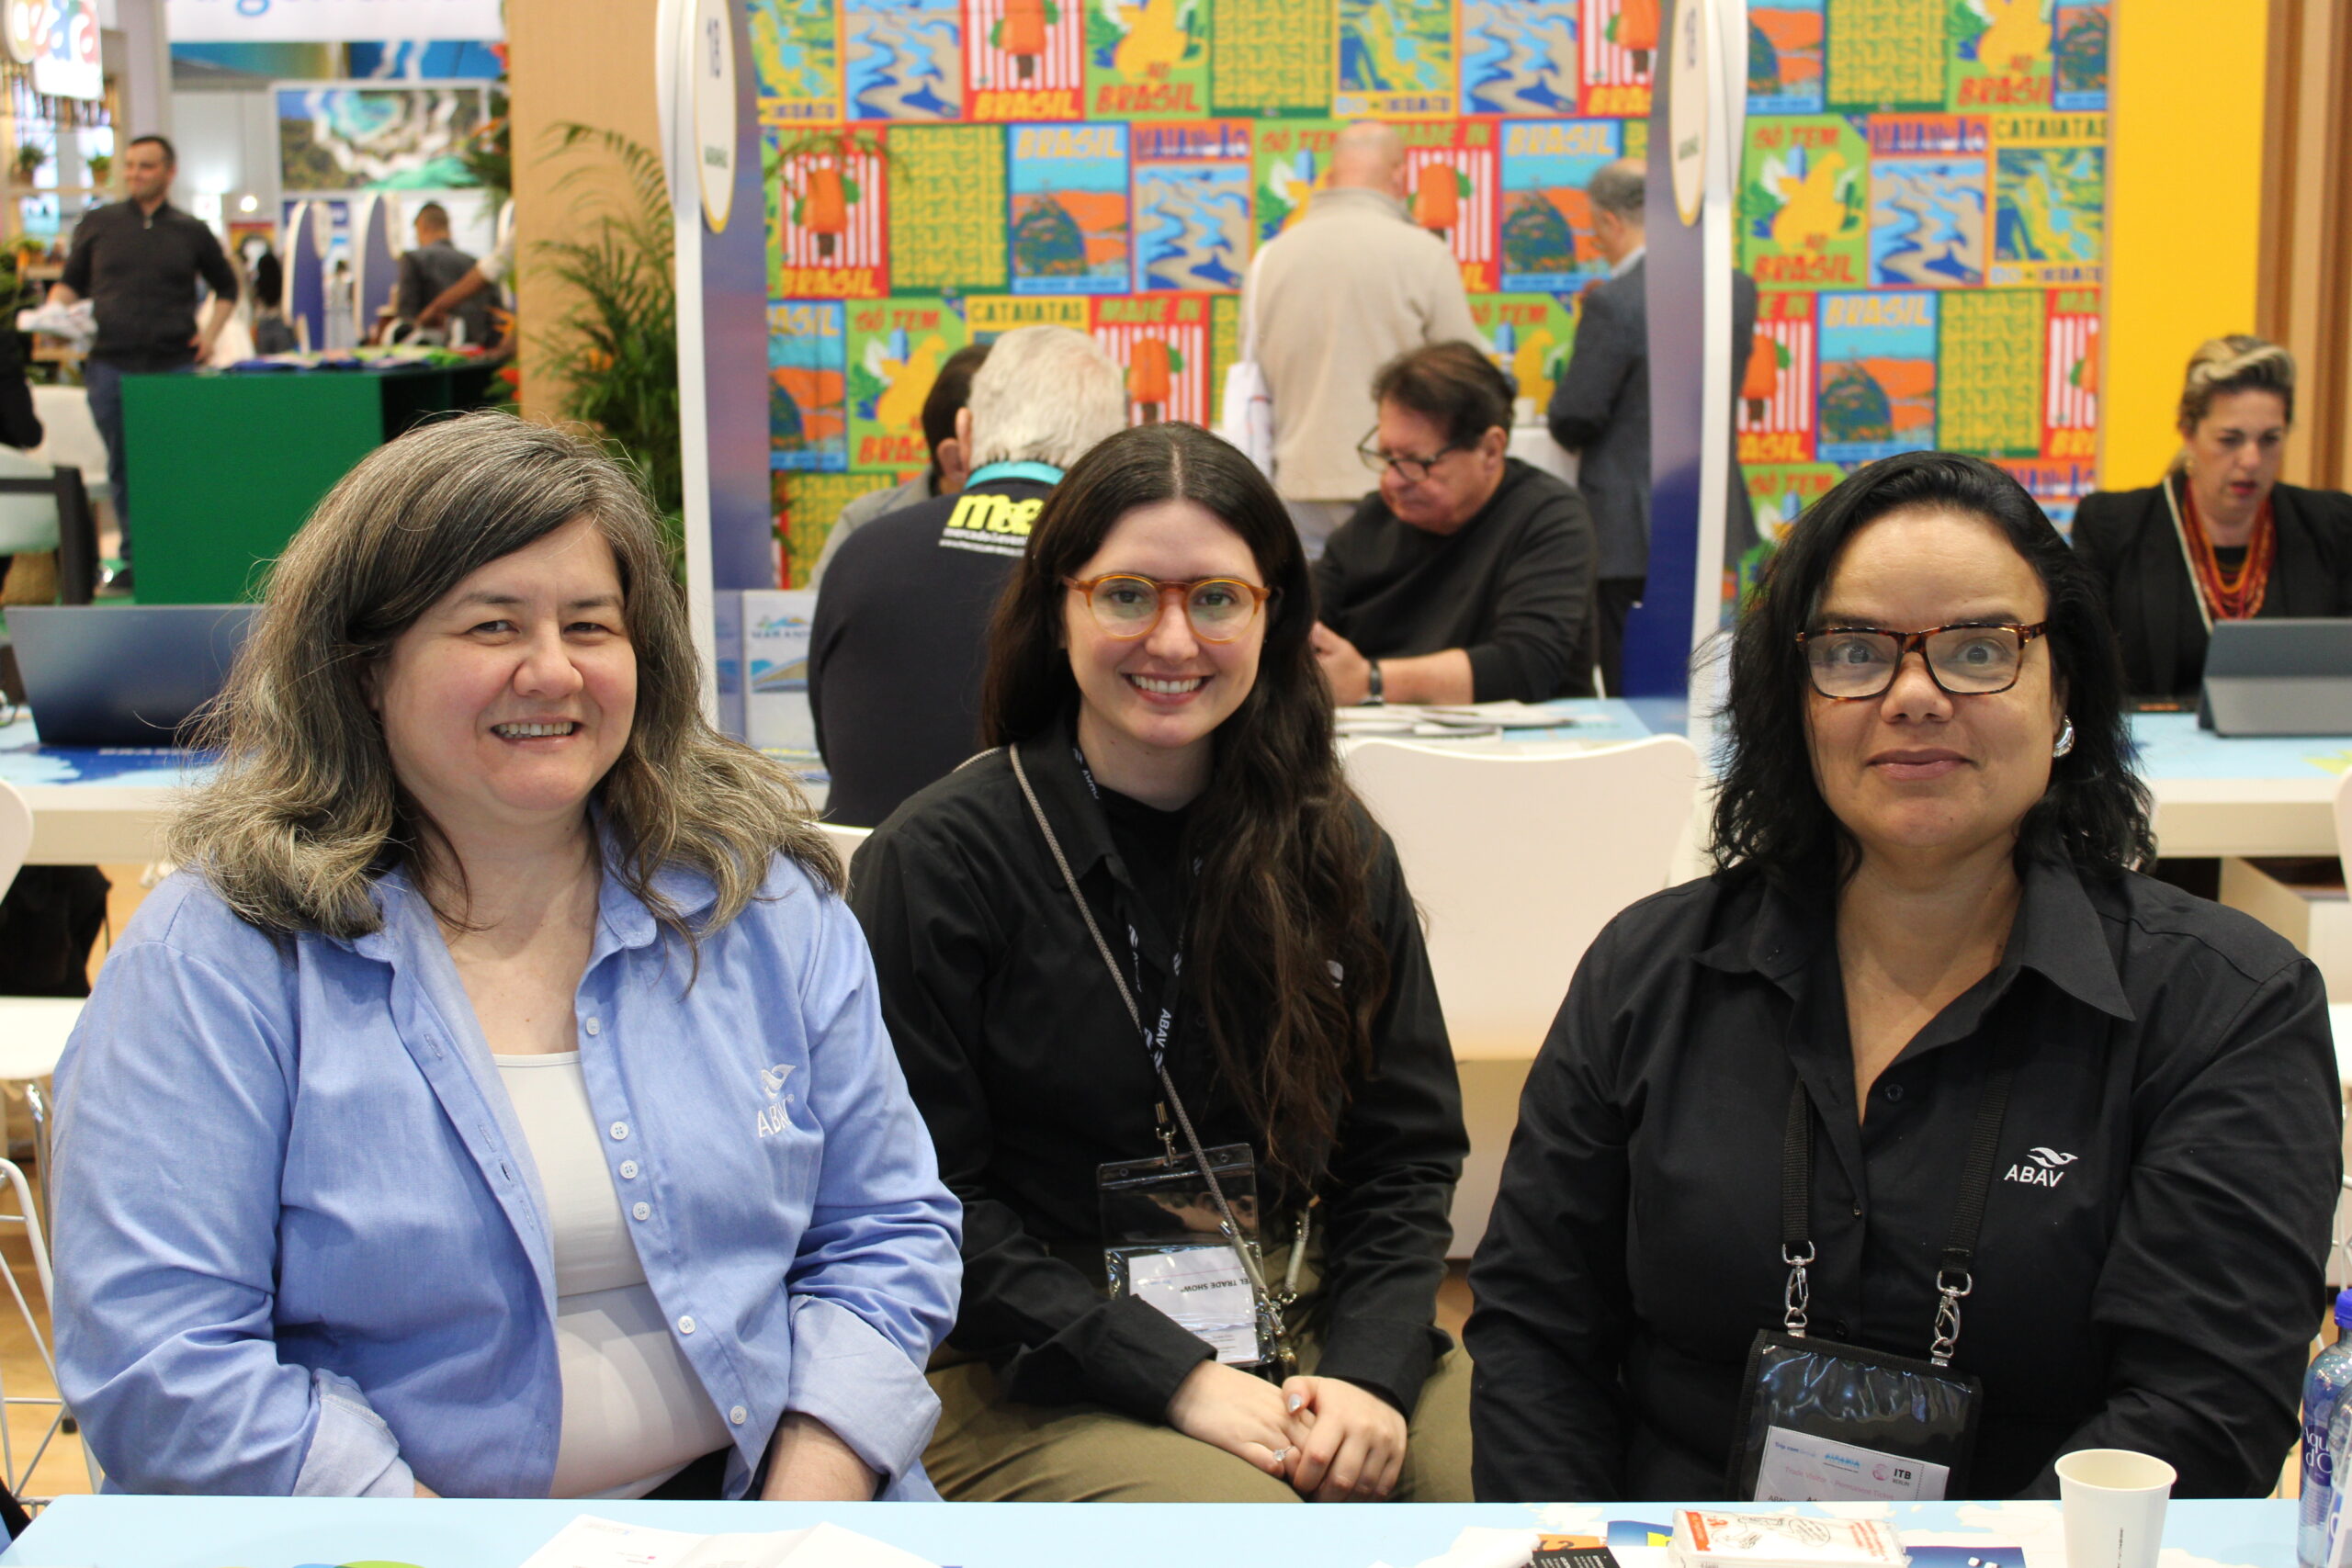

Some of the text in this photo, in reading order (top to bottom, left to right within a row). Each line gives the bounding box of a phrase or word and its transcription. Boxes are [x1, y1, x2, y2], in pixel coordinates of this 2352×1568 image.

[973, 91, 1080, 120] BRASIL
[1094, 84, 1202, 114] BRASIL
[1015, 128, 1124, 160] BRASIL
[1507, 124, 1615, 157] BRASIL
[1791, 125, 1841, 150] TEM
[1750, 253, 1858, 285] BRASIL
[765, 304, 841, 337] ASIL
[891, 309, 941, 333] TEM
[1097, 299, 1169, 321] MADE
[1499, 303, 1548, 326] TEM
[1825, 294, 1932, 328] BRASIL
[1737, 432, 1808, 461] ASIL
[1155, 1008, 1172, 1049] ABAV
[2003, 1164, 2065, 1188] ABAV
[1210, 1279, 1238, 1289] TRADE
[1891, 1478, 1911, 1488] BERLIN
[1893, 1468, 1912, 1480] ITB
